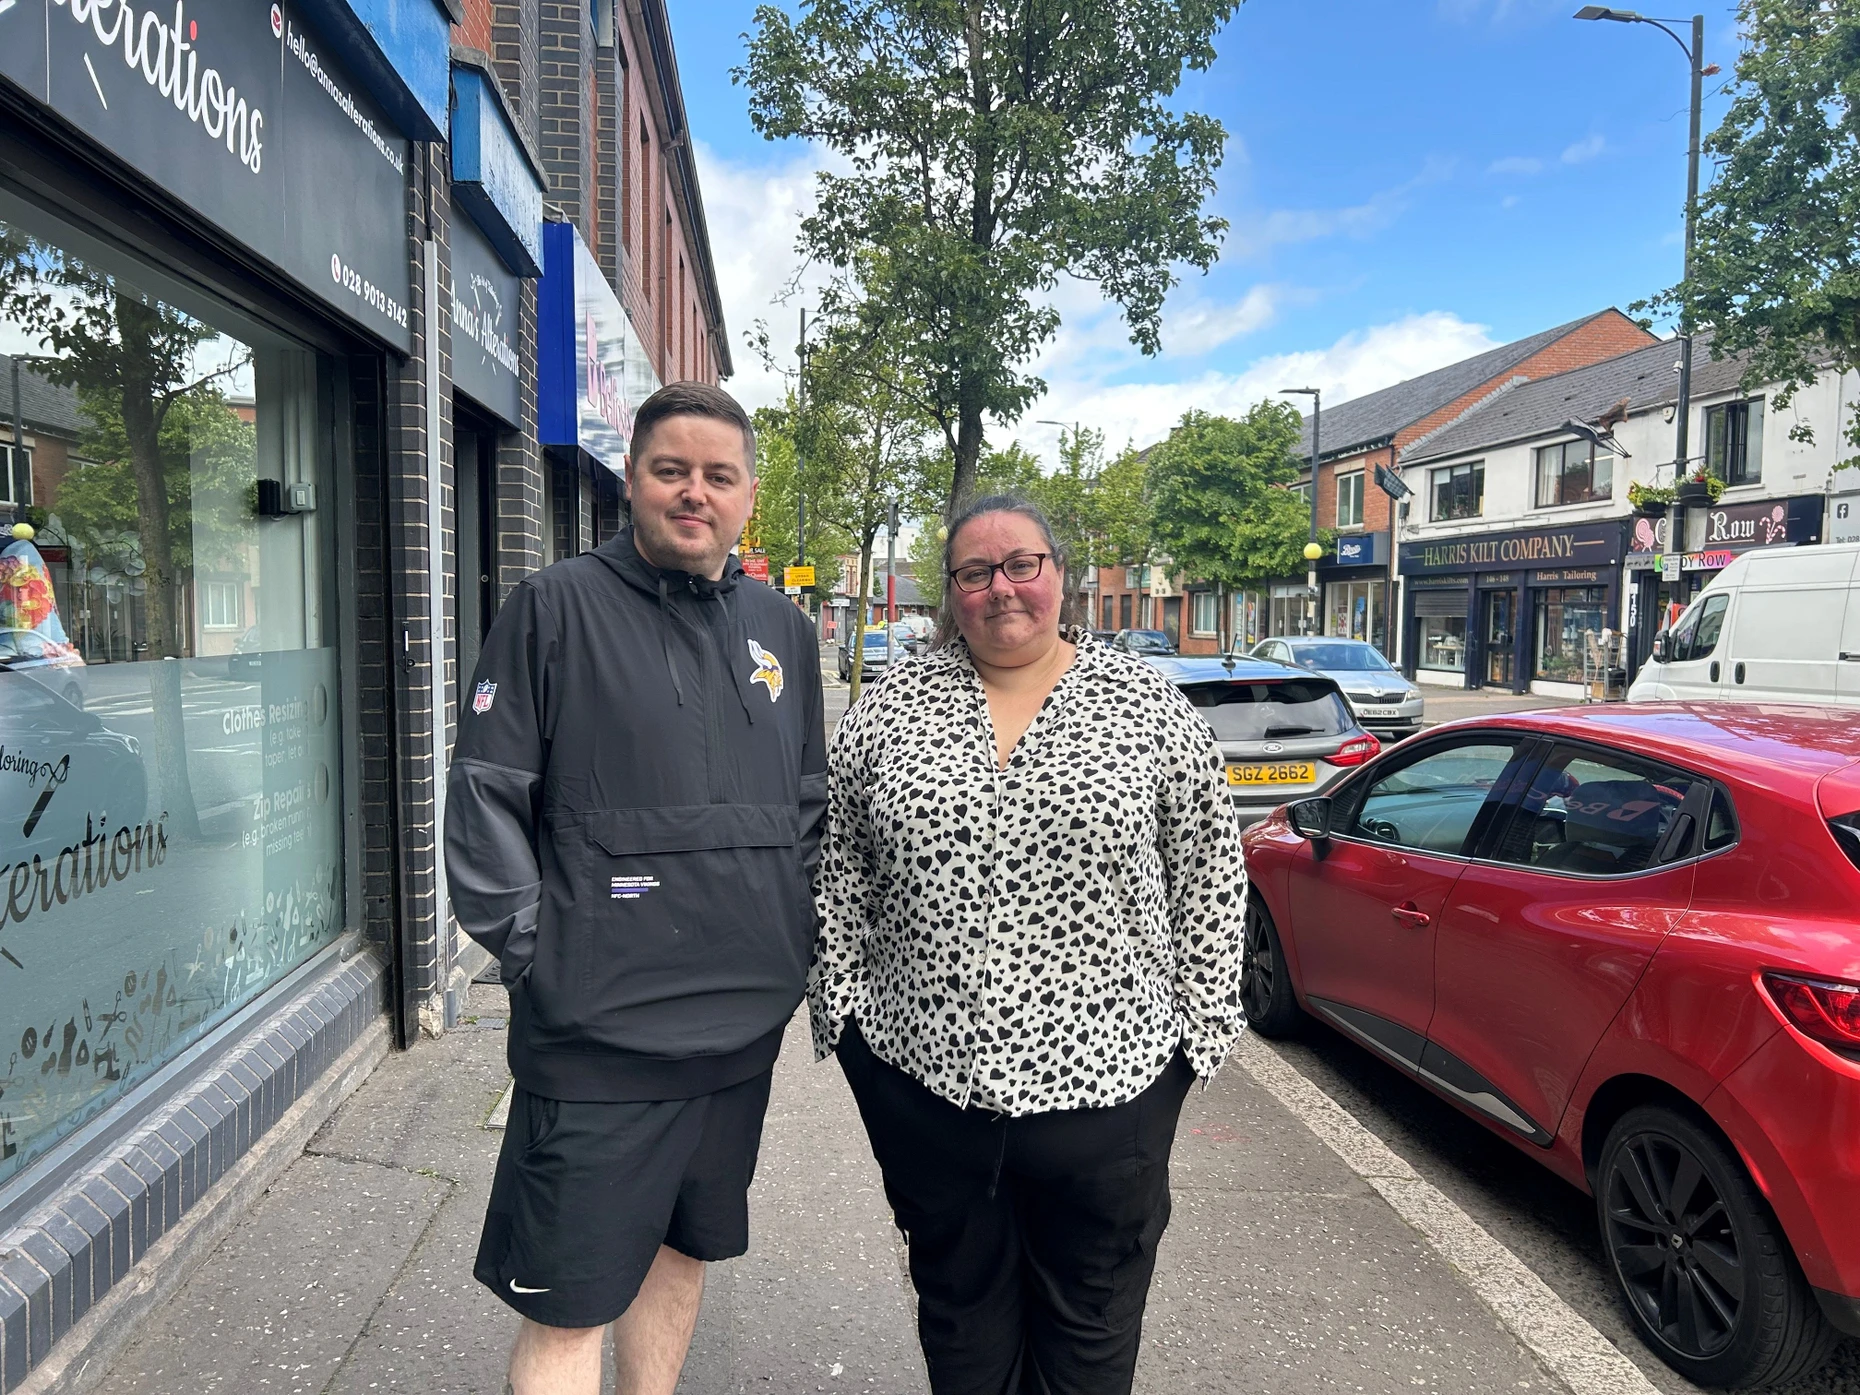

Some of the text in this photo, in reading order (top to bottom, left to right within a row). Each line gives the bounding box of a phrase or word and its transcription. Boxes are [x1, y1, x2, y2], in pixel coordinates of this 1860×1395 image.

[286, 20, 404, 176] hello@annasalterations.co.uk
[342, 264, 407, 329] 028 9013 5142
[450, 279, 479, 342] Anna's
[481, 310, 519, 378] Alterations
[1340, 543, 1362, 556] Boots
[1423, 534, 1574, 566] HARRIS KILT COMPANY
[1536, 570, 1597, 582] Harris Tailoring
[222, 705, 266, 736] Clothes
[1232, 764, 1309, 782] SGZ 2662
[253, 793, 271, 821] Zip
[242, 829, 260, 849] (e.g.
[260, 817, 287, 839] broken
[266, 834, 293, 857] missing
